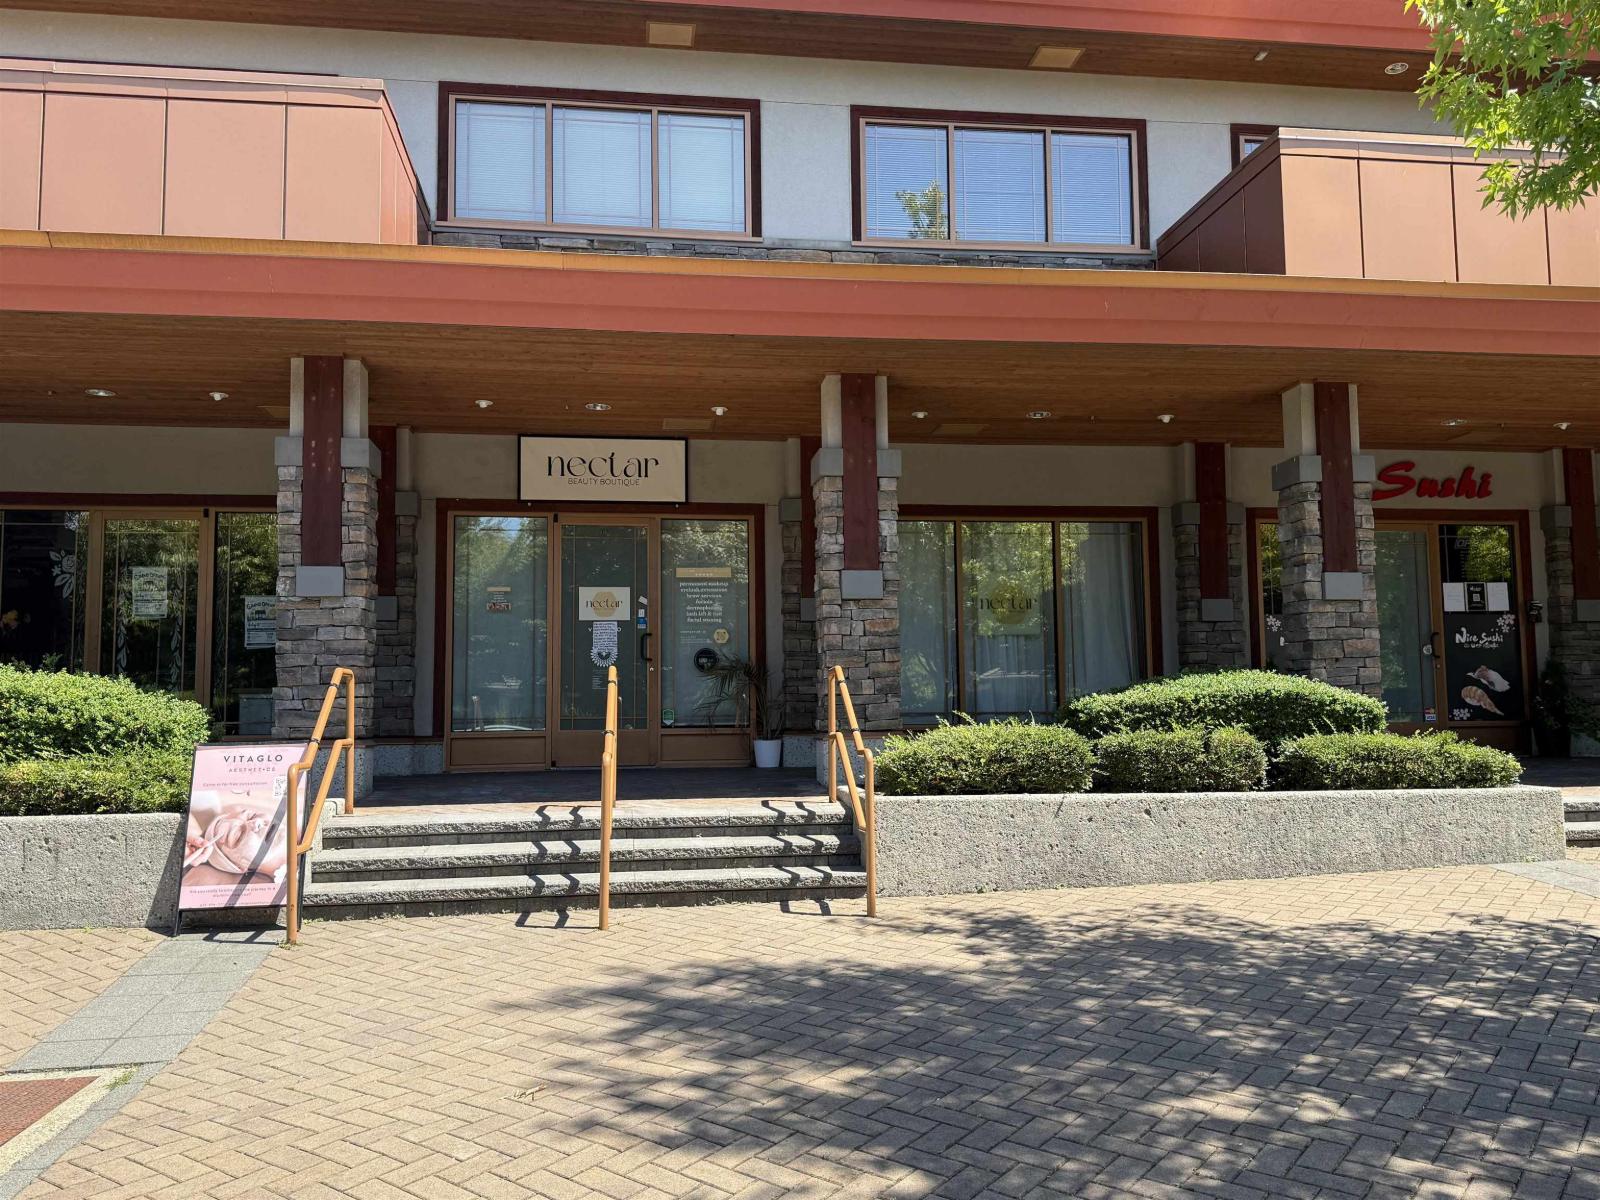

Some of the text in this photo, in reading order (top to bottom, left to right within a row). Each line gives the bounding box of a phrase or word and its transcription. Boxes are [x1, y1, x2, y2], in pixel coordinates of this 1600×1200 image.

[547, 452, 659, 478] nectar
[600, 478, 640, 487] BOUTIQUE
[1371, 460, 1493, 501] Sushi
[585, 599, 623, 608] nectar
[1455, 627, 1503, 644] Nice Sushi
[224, 754, 283, 763] VITAGLO
